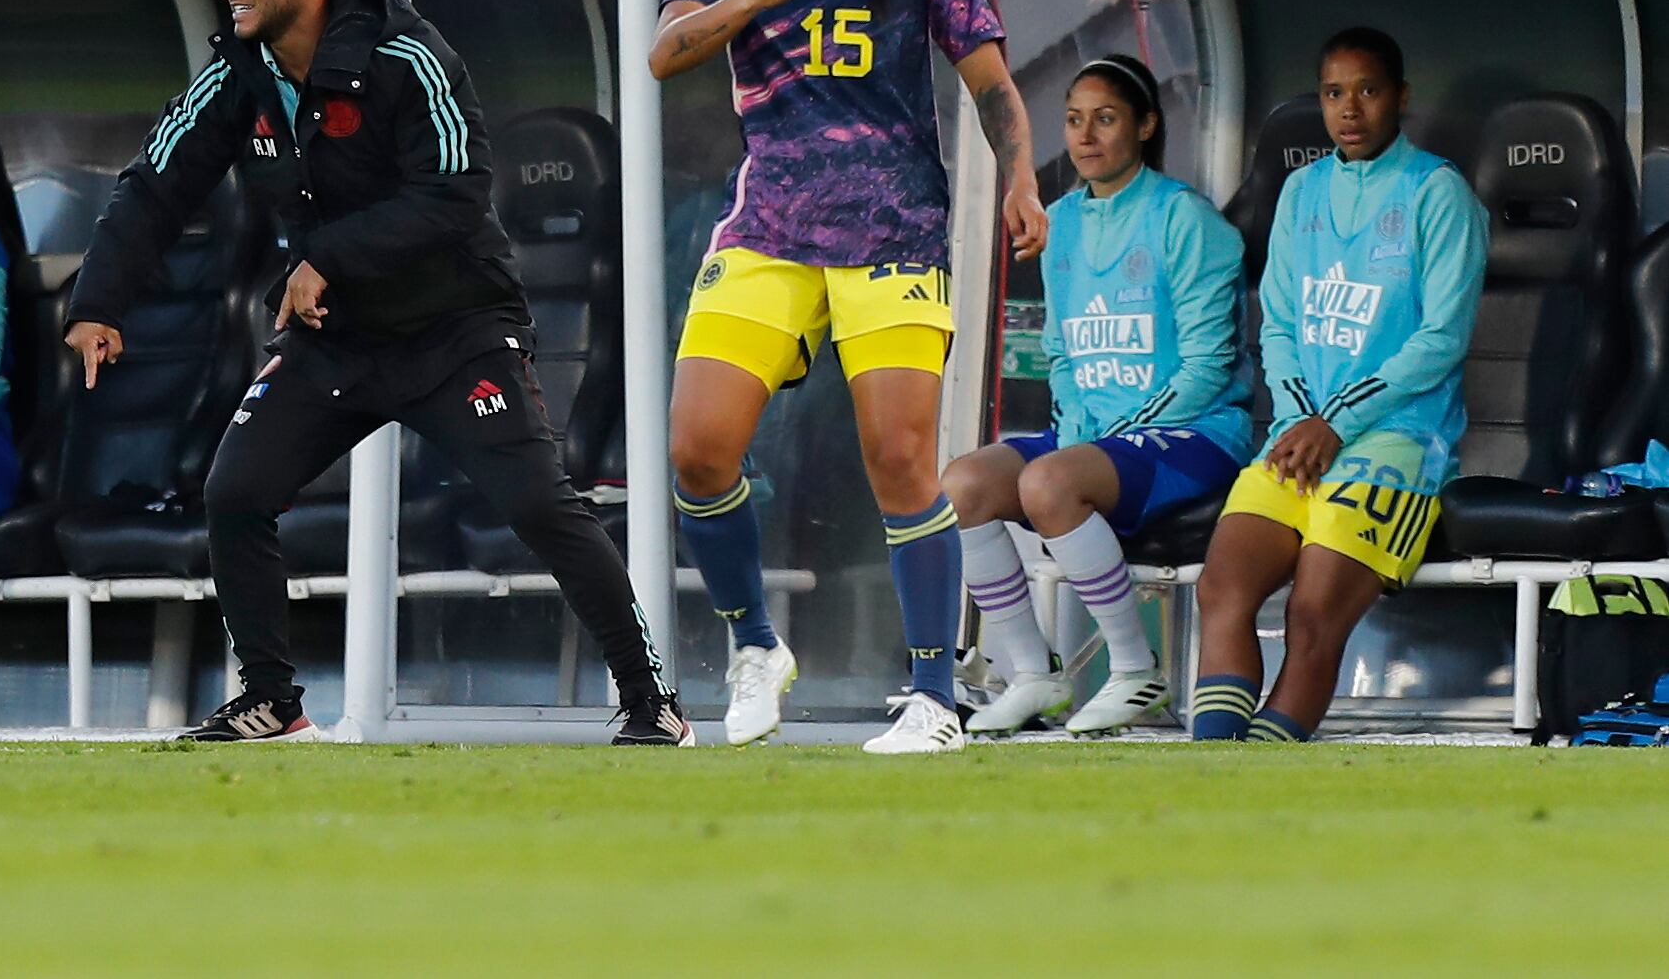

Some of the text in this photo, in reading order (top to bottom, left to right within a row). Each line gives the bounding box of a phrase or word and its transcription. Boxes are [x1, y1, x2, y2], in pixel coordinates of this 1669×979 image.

[801, 8, 873, 78] 15
[1283, 147, 1333, 169] IDR
[1507, 143, 1565, 167] IDRD
[521, 161, 575, 186] IDRD
[1073, 357, 1155, 391] etPlay
[1326, 456, 1406, 524] 20
